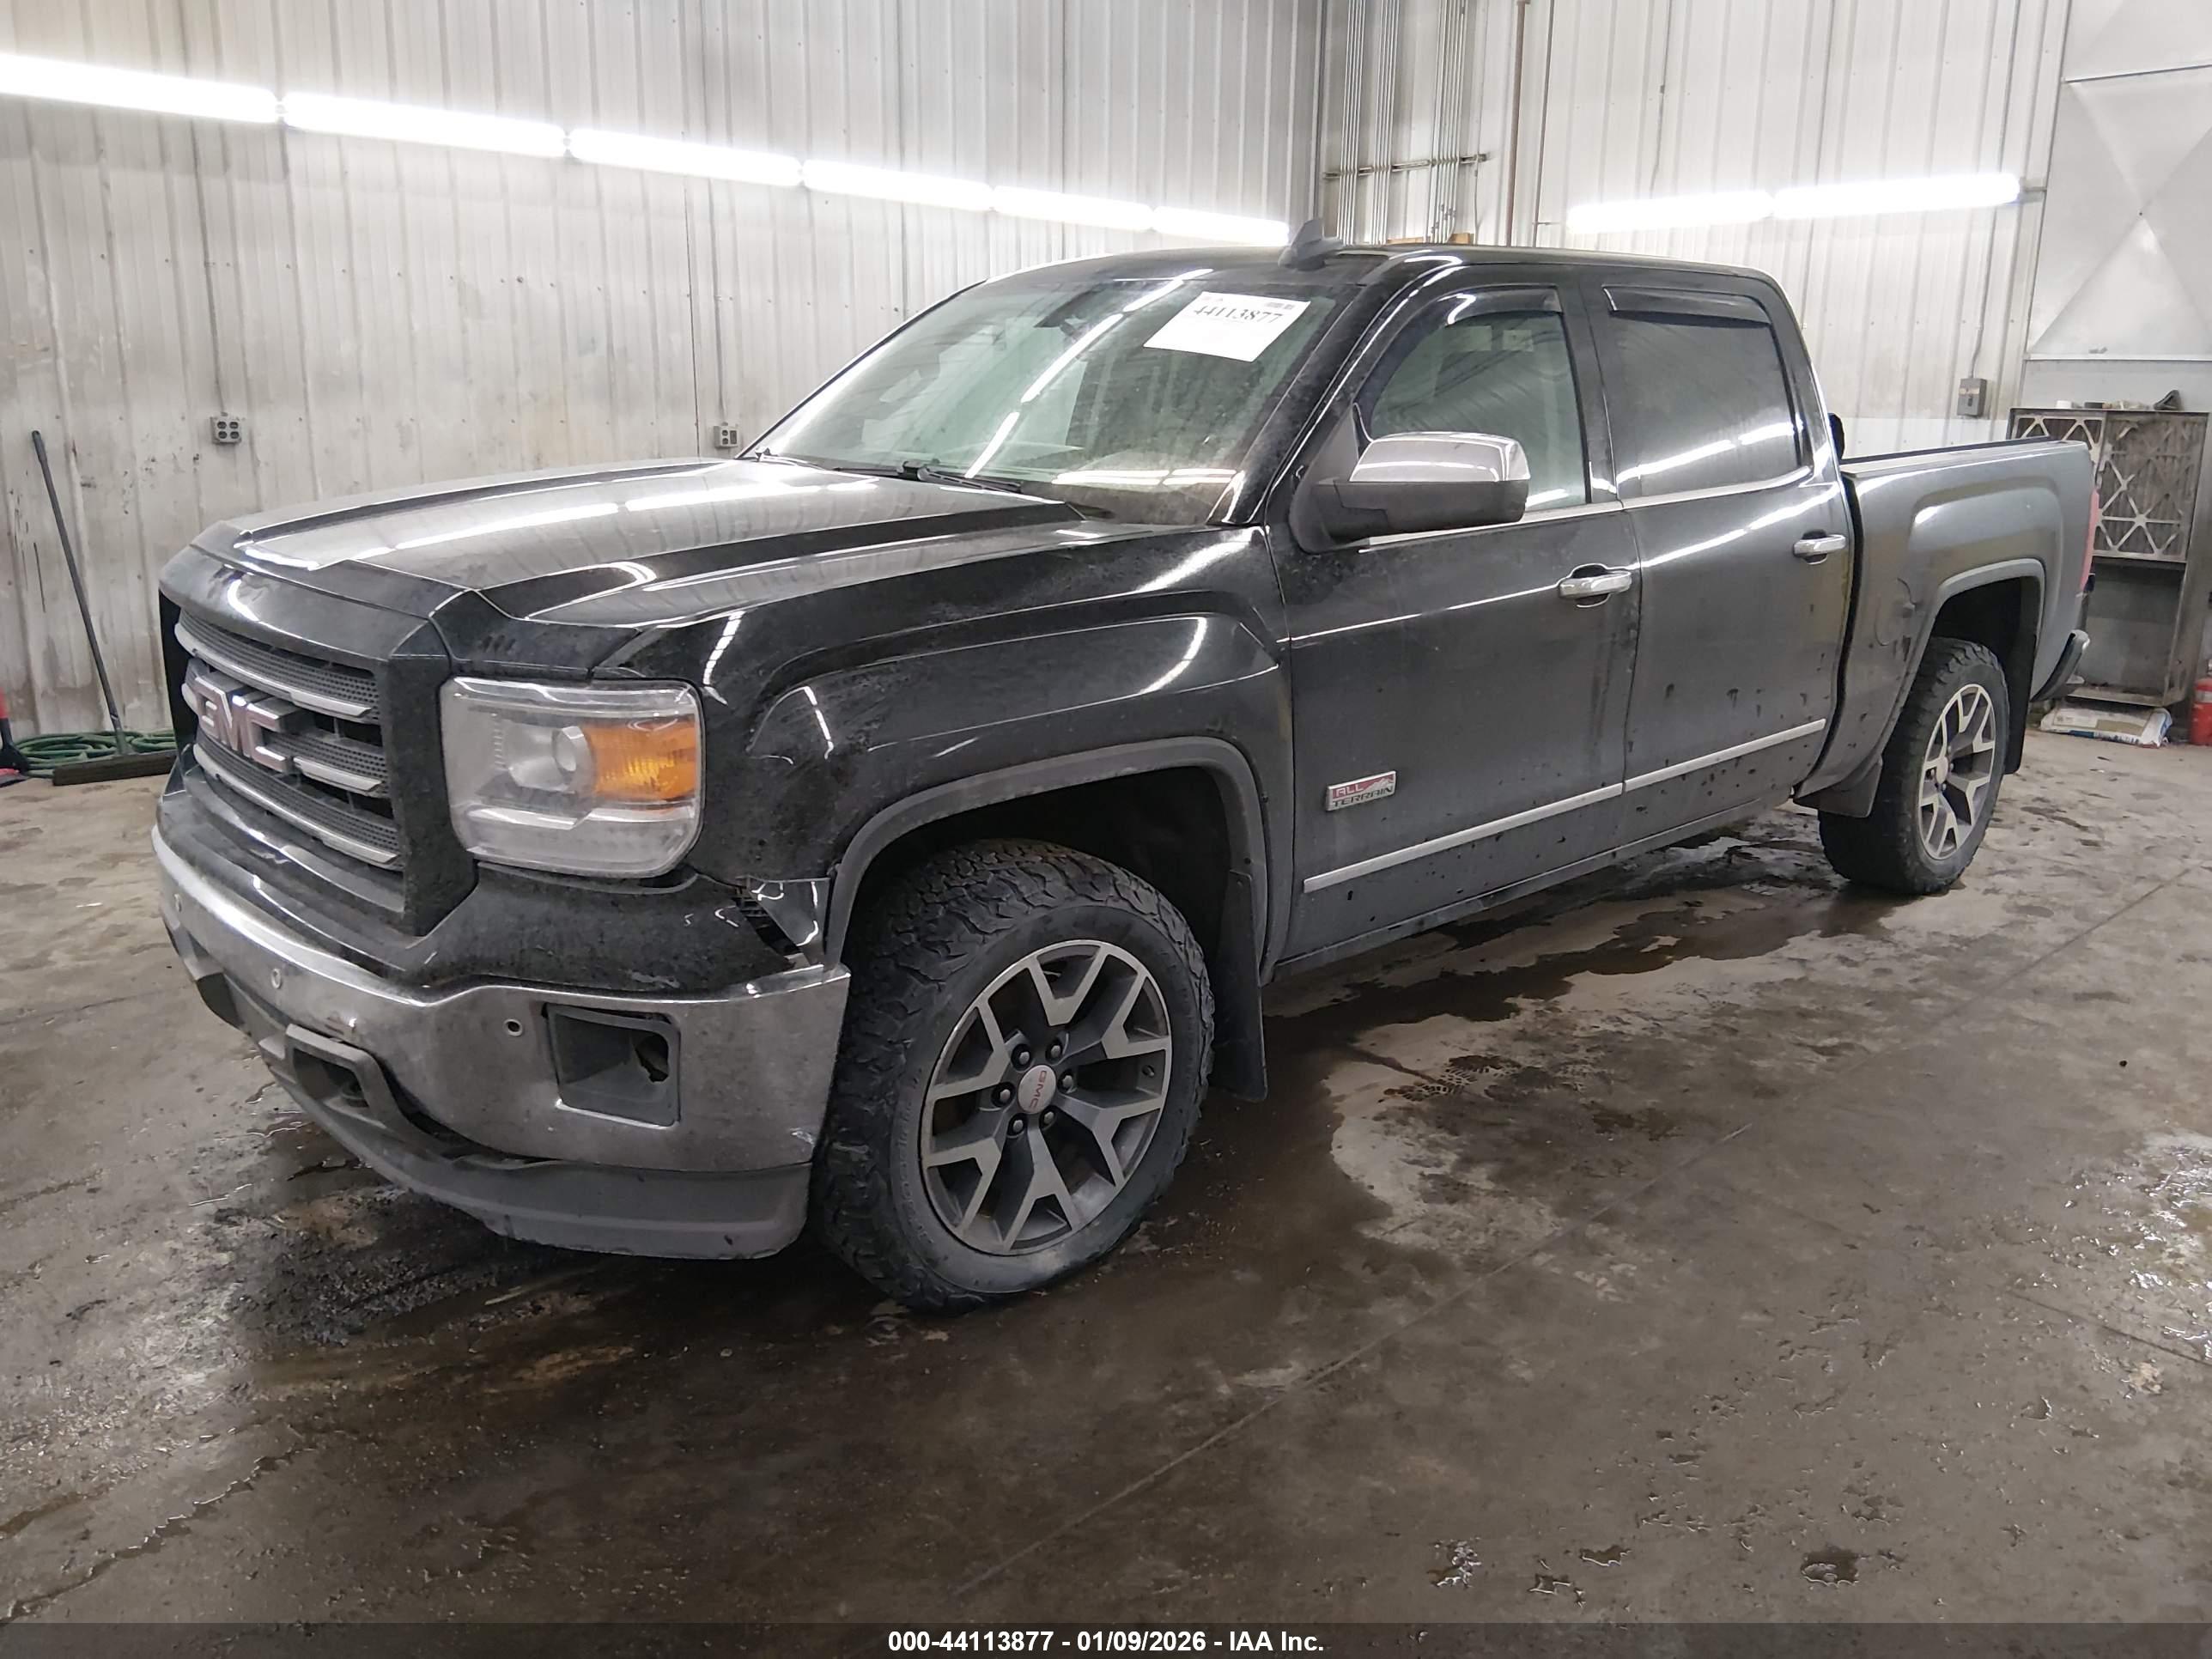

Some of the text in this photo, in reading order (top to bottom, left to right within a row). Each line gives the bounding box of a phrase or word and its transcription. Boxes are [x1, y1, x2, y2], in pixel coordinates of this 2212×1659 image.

[1194, 305, 1284, 324] 44113877
[188, 676, 289, 774] GMC
[1332, 785, 1393, 807] TERRAIN
[1335, 783, 1364, 798] ALL
[1030, 1070, 1047, 1110] GMC
